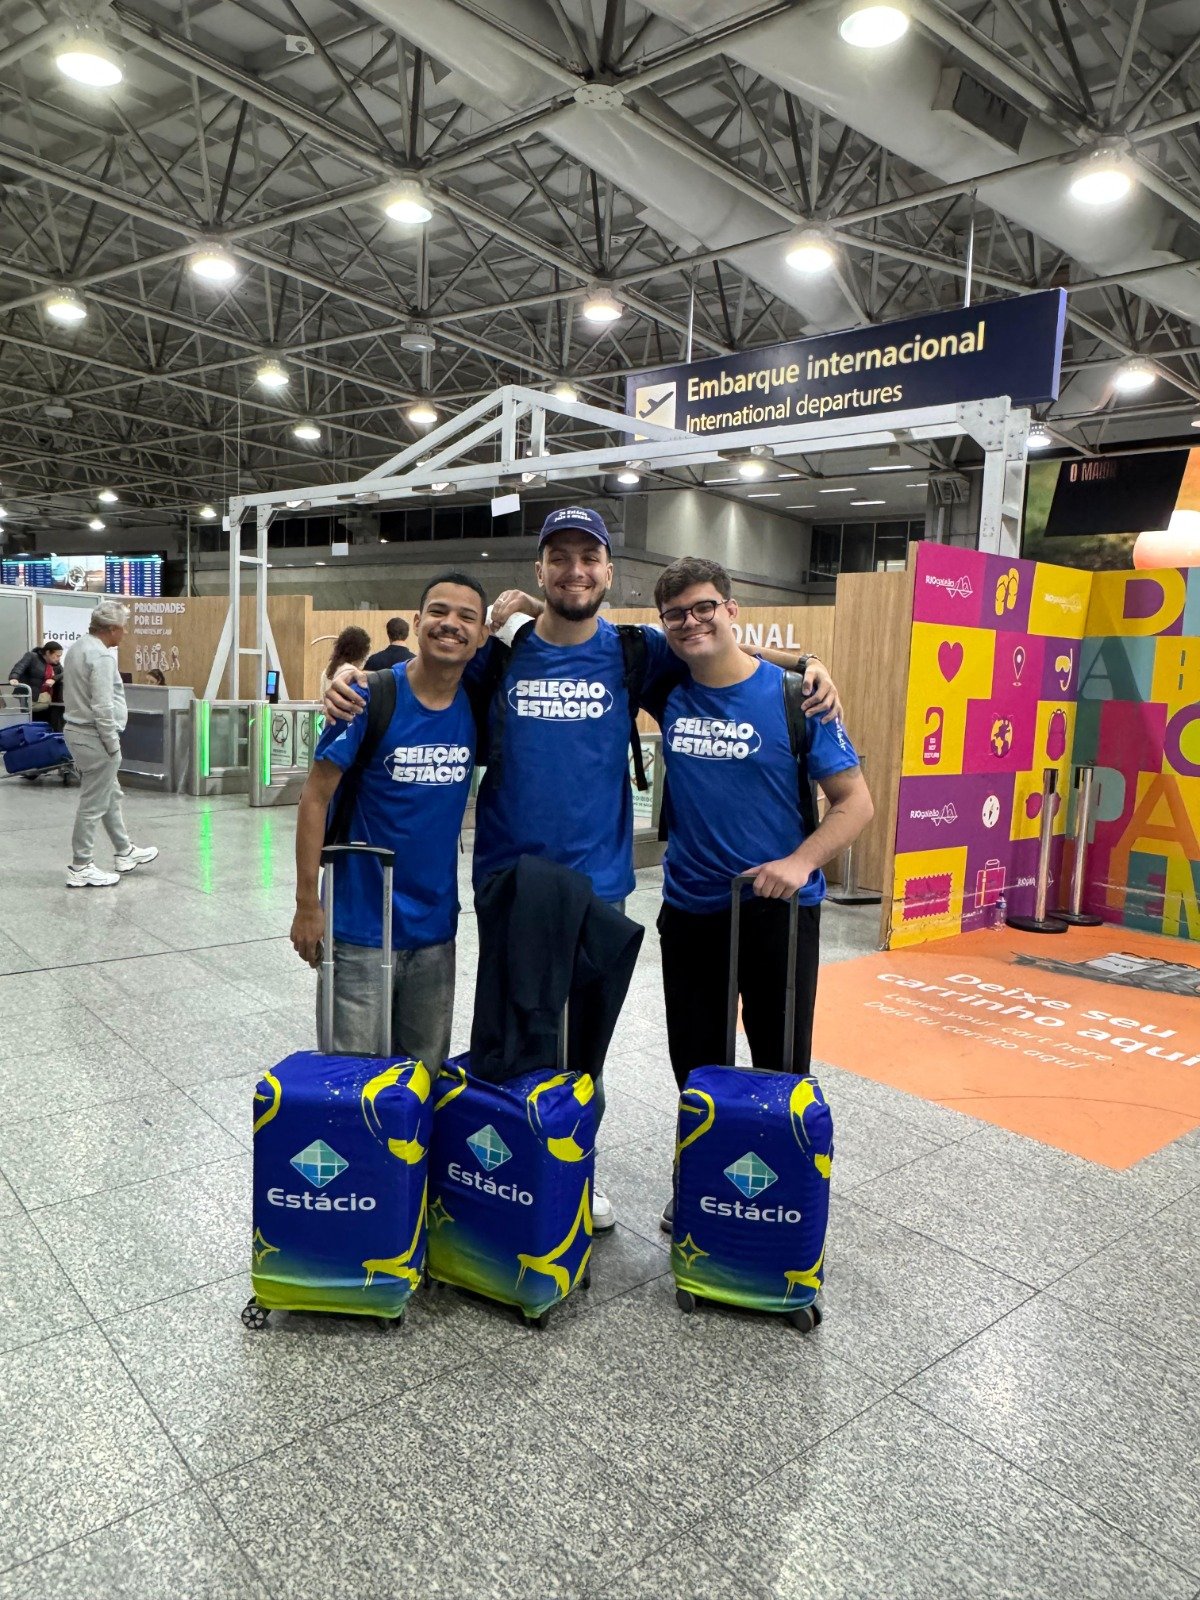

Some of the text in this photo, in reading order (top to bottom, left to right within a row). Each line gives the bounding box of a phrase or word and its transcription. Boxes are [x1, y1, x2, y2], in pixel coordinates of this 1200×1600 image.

[687, 321, 986, 402] Embarque internacional
[686, 383, 903, 434] International departures
[1070, 463, 1078, 483] O
[134, 602, 186, 614] PRIORIDADES
[134, 615, 163, 626] POR LEI
[516, 678, 606, 702] SELEÇÃO
[517, 697, 604, 719] ESTÁCIO
[674, 718, 754, 741] SELEÇÃO
[393, 744, 470, 767] SELEÇÃO
[671, 736, 749, 760] ESTÁCIO
[392, 762, 467, 783] ESTÁCIO
[944, 973, 1178, 1038] Deixe seu
[863, 1001, 913, 1018] Deja
[914, 1016, 942, 1026] tu
[942, 1025, 1019, 1050] carrito
[877, 973, 1200, 1067] carrinho aqui
[884, 993, 1113, 1062] Leave your cart here
[448, 1162, 534, 1206] Estácio
[267, 1187, 377, 1212] Estácio
[700, 1195, 802, 1224] Estácio
